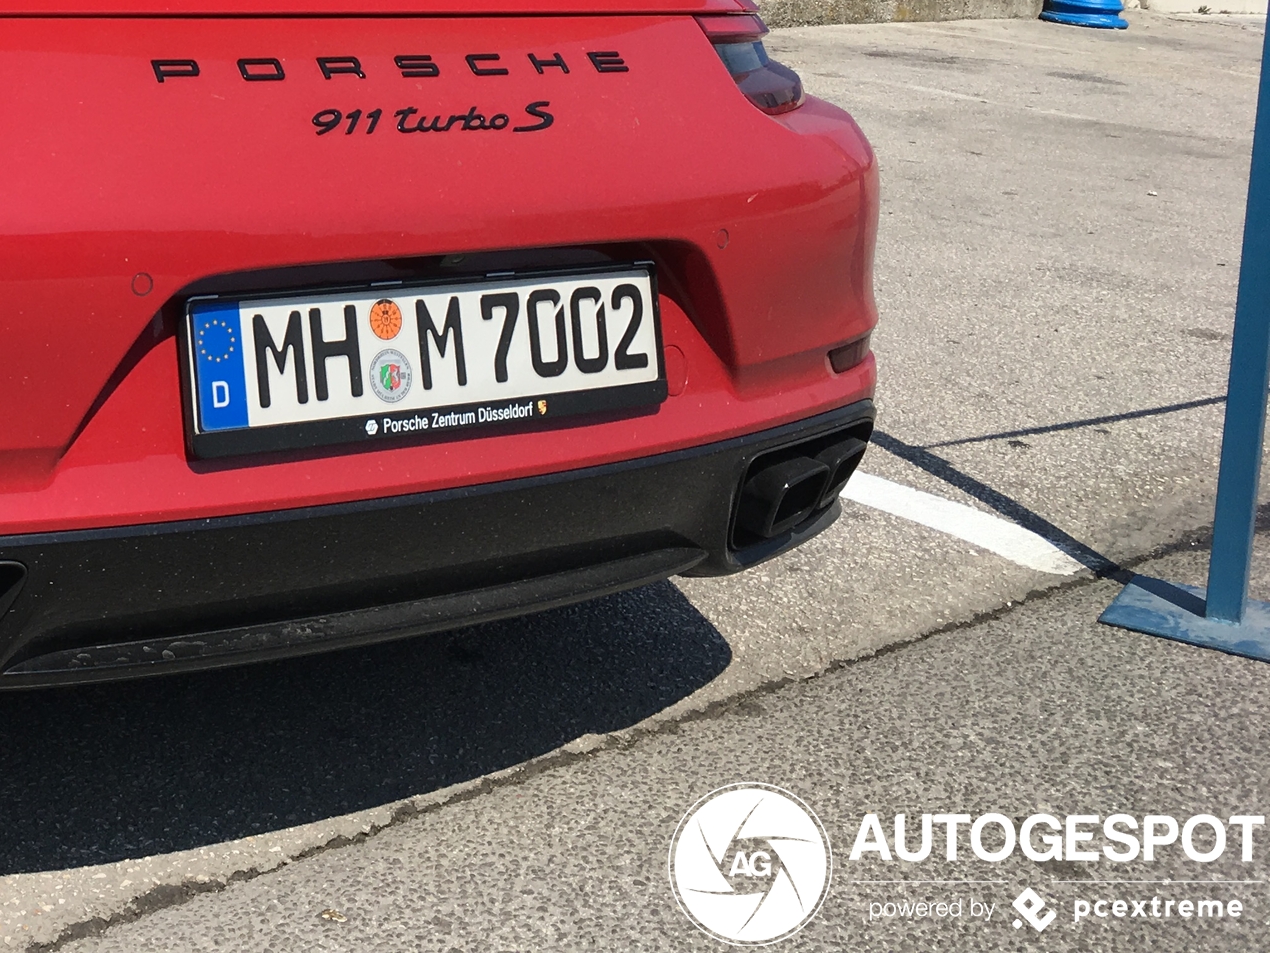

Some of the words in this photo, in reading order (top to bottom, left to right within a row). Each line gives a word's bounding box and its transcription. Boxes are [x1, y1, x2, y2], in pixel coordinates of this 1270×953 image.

[150, 51, 630, 83] PORSCHE
[312, 108, 383, 135] 911
[394, 105, 511, 133] turbo
[513, 101, 555, 132] S
[252, 304, 364, 409] MH
[212, 380, 230, 409] D
[383, 414, 429, 434] Porsche
[431, 410, 476, 429] Zentrum
[478, 401, 533, 423] Düsseldorf
